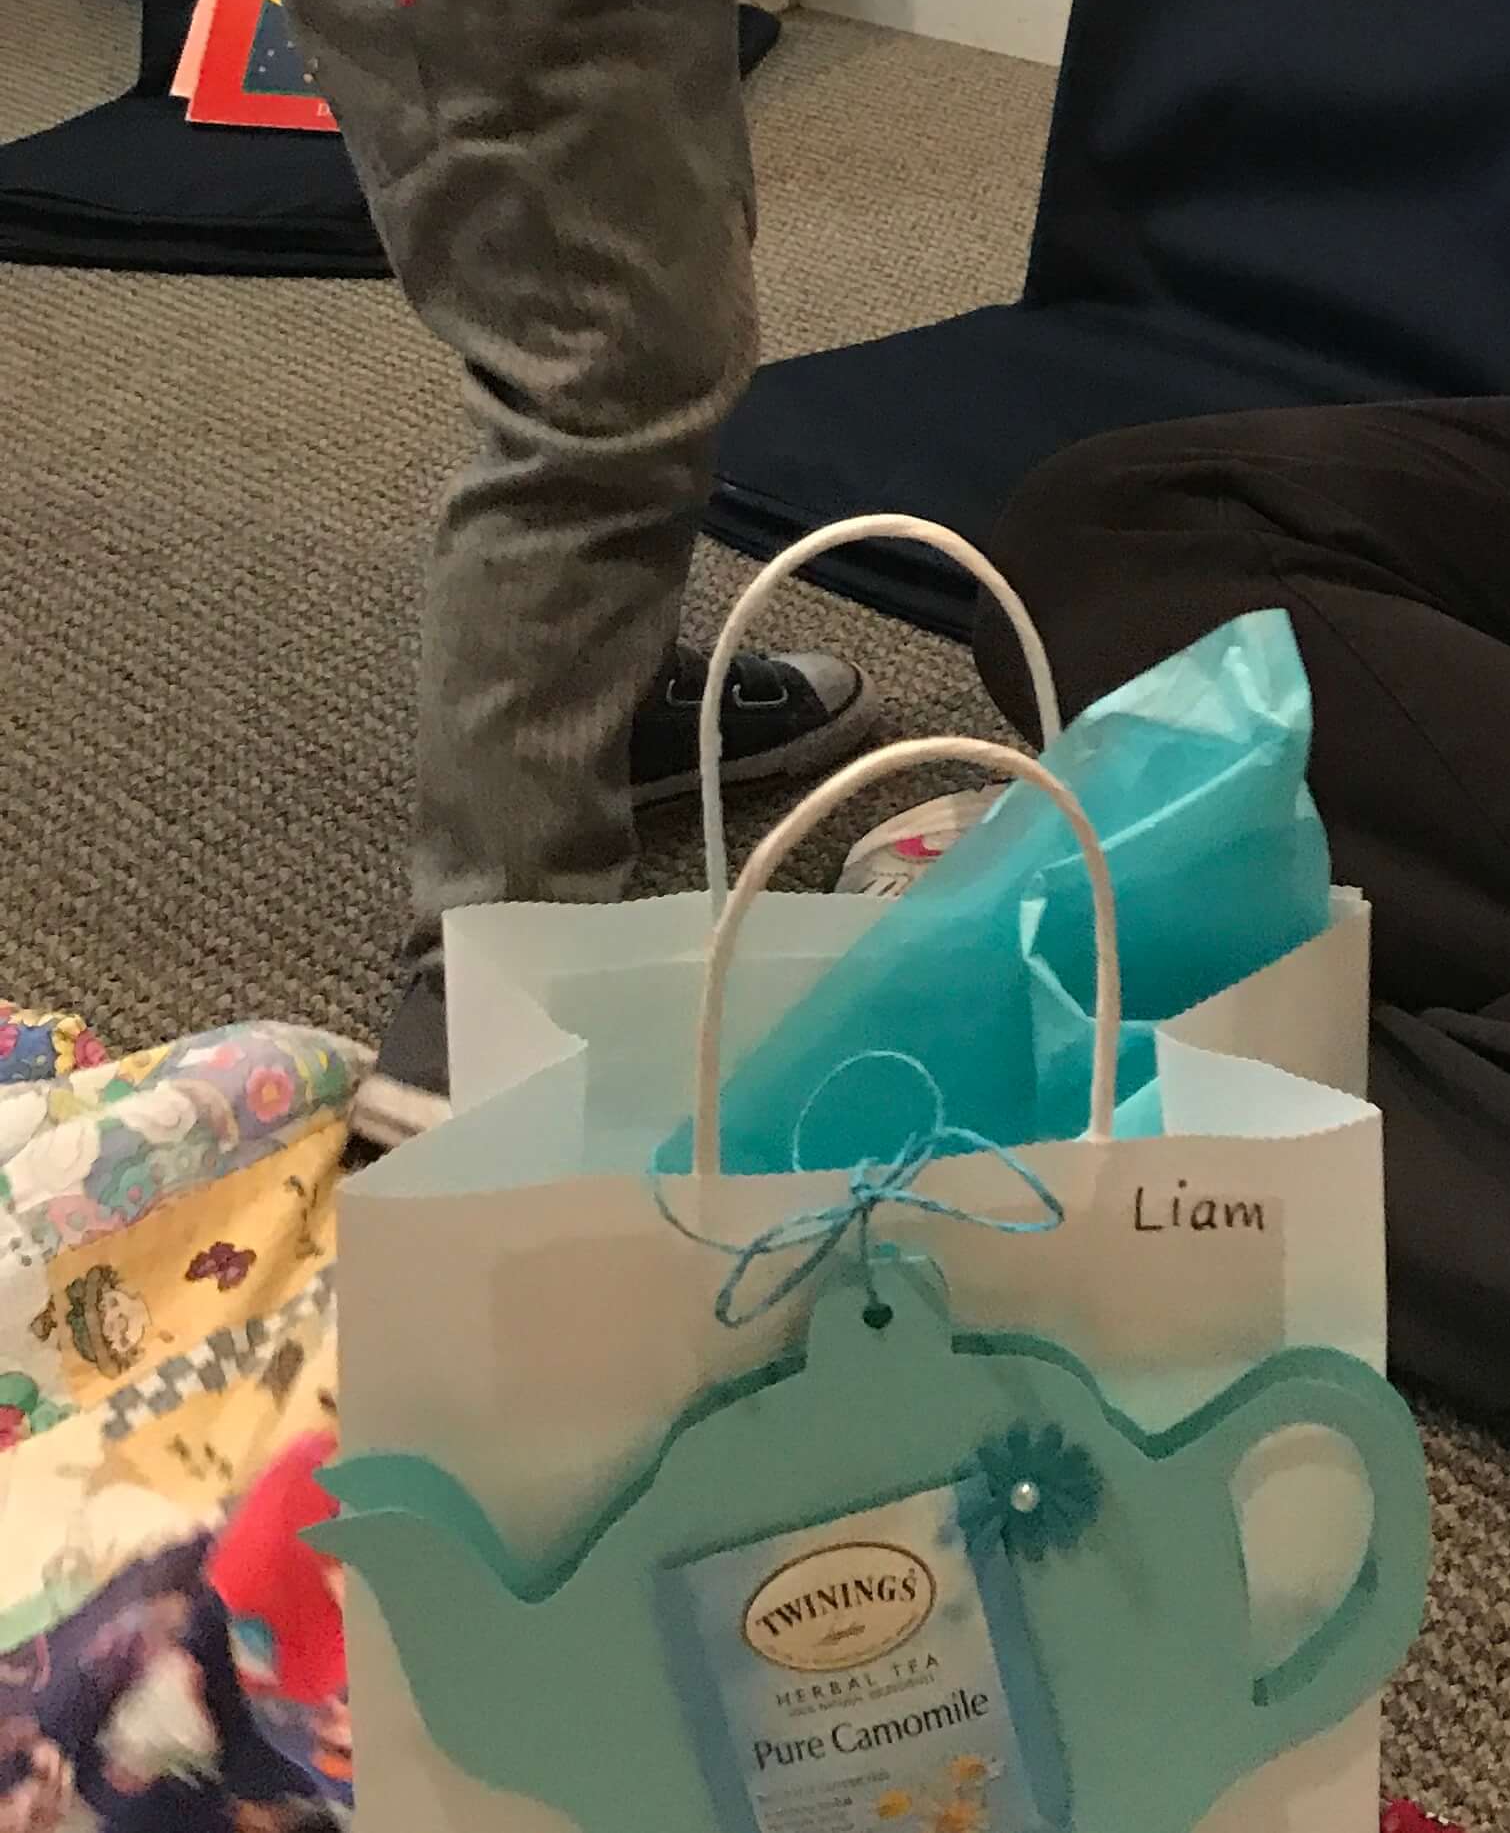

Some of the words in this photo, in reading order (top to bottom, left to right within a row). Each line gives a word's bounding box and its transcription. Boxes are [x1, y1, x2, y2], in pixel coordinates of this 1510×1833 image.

[1134, 1179, 1264, 1231] Liam
[756, 1573, 917, 1637] TWININGS
[776, 1672, 877, 1706] HERBAL
[892, 1653, 940, 1676] TEA
[753, 1736, 826, 1771] Pure
[832, 1689, 990, 1754] Camomile
